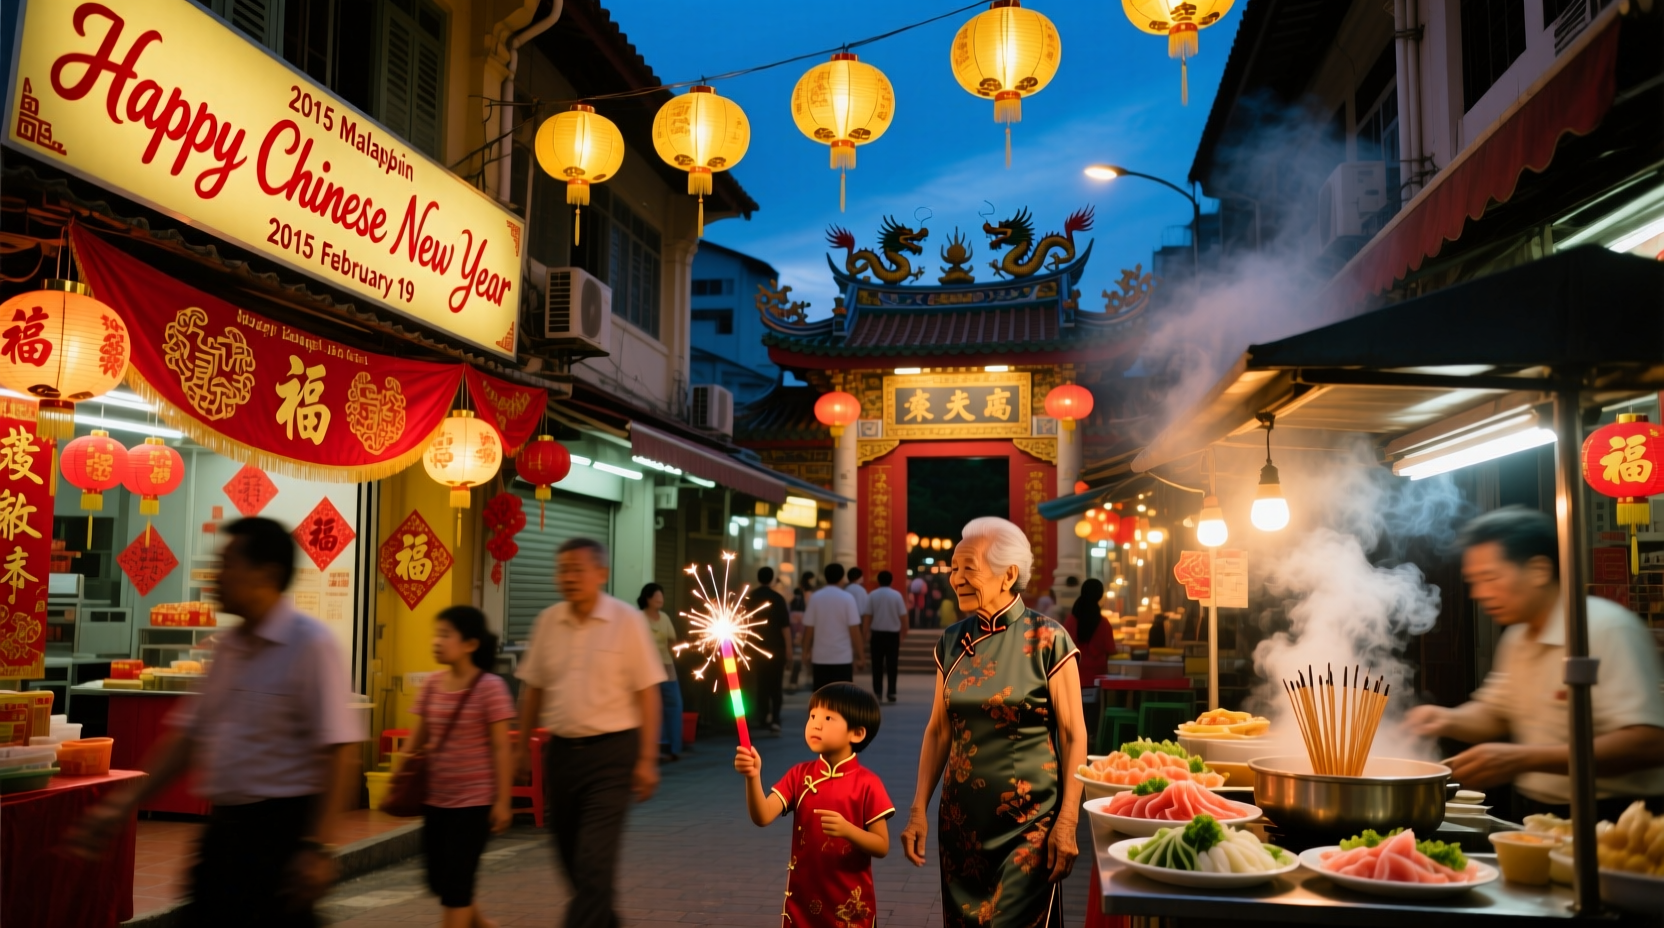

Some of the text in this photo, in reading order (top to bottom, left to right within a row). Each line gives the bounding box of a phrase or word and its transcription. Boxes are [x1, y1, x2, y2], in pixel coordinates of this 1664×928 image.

[288, 85, 335, 131] 2015
[50, 2, 512, 313] Happy Chinese New Year
[266, 217, 415, 303] 2015 February 19
[1, 305, 53, 368] 福
[275, 354, 332, 446] 福
[1599, 434, 1653, 485] 福
[308, 516, 339, 552] 福
[395, 533, 433, 582] 福
